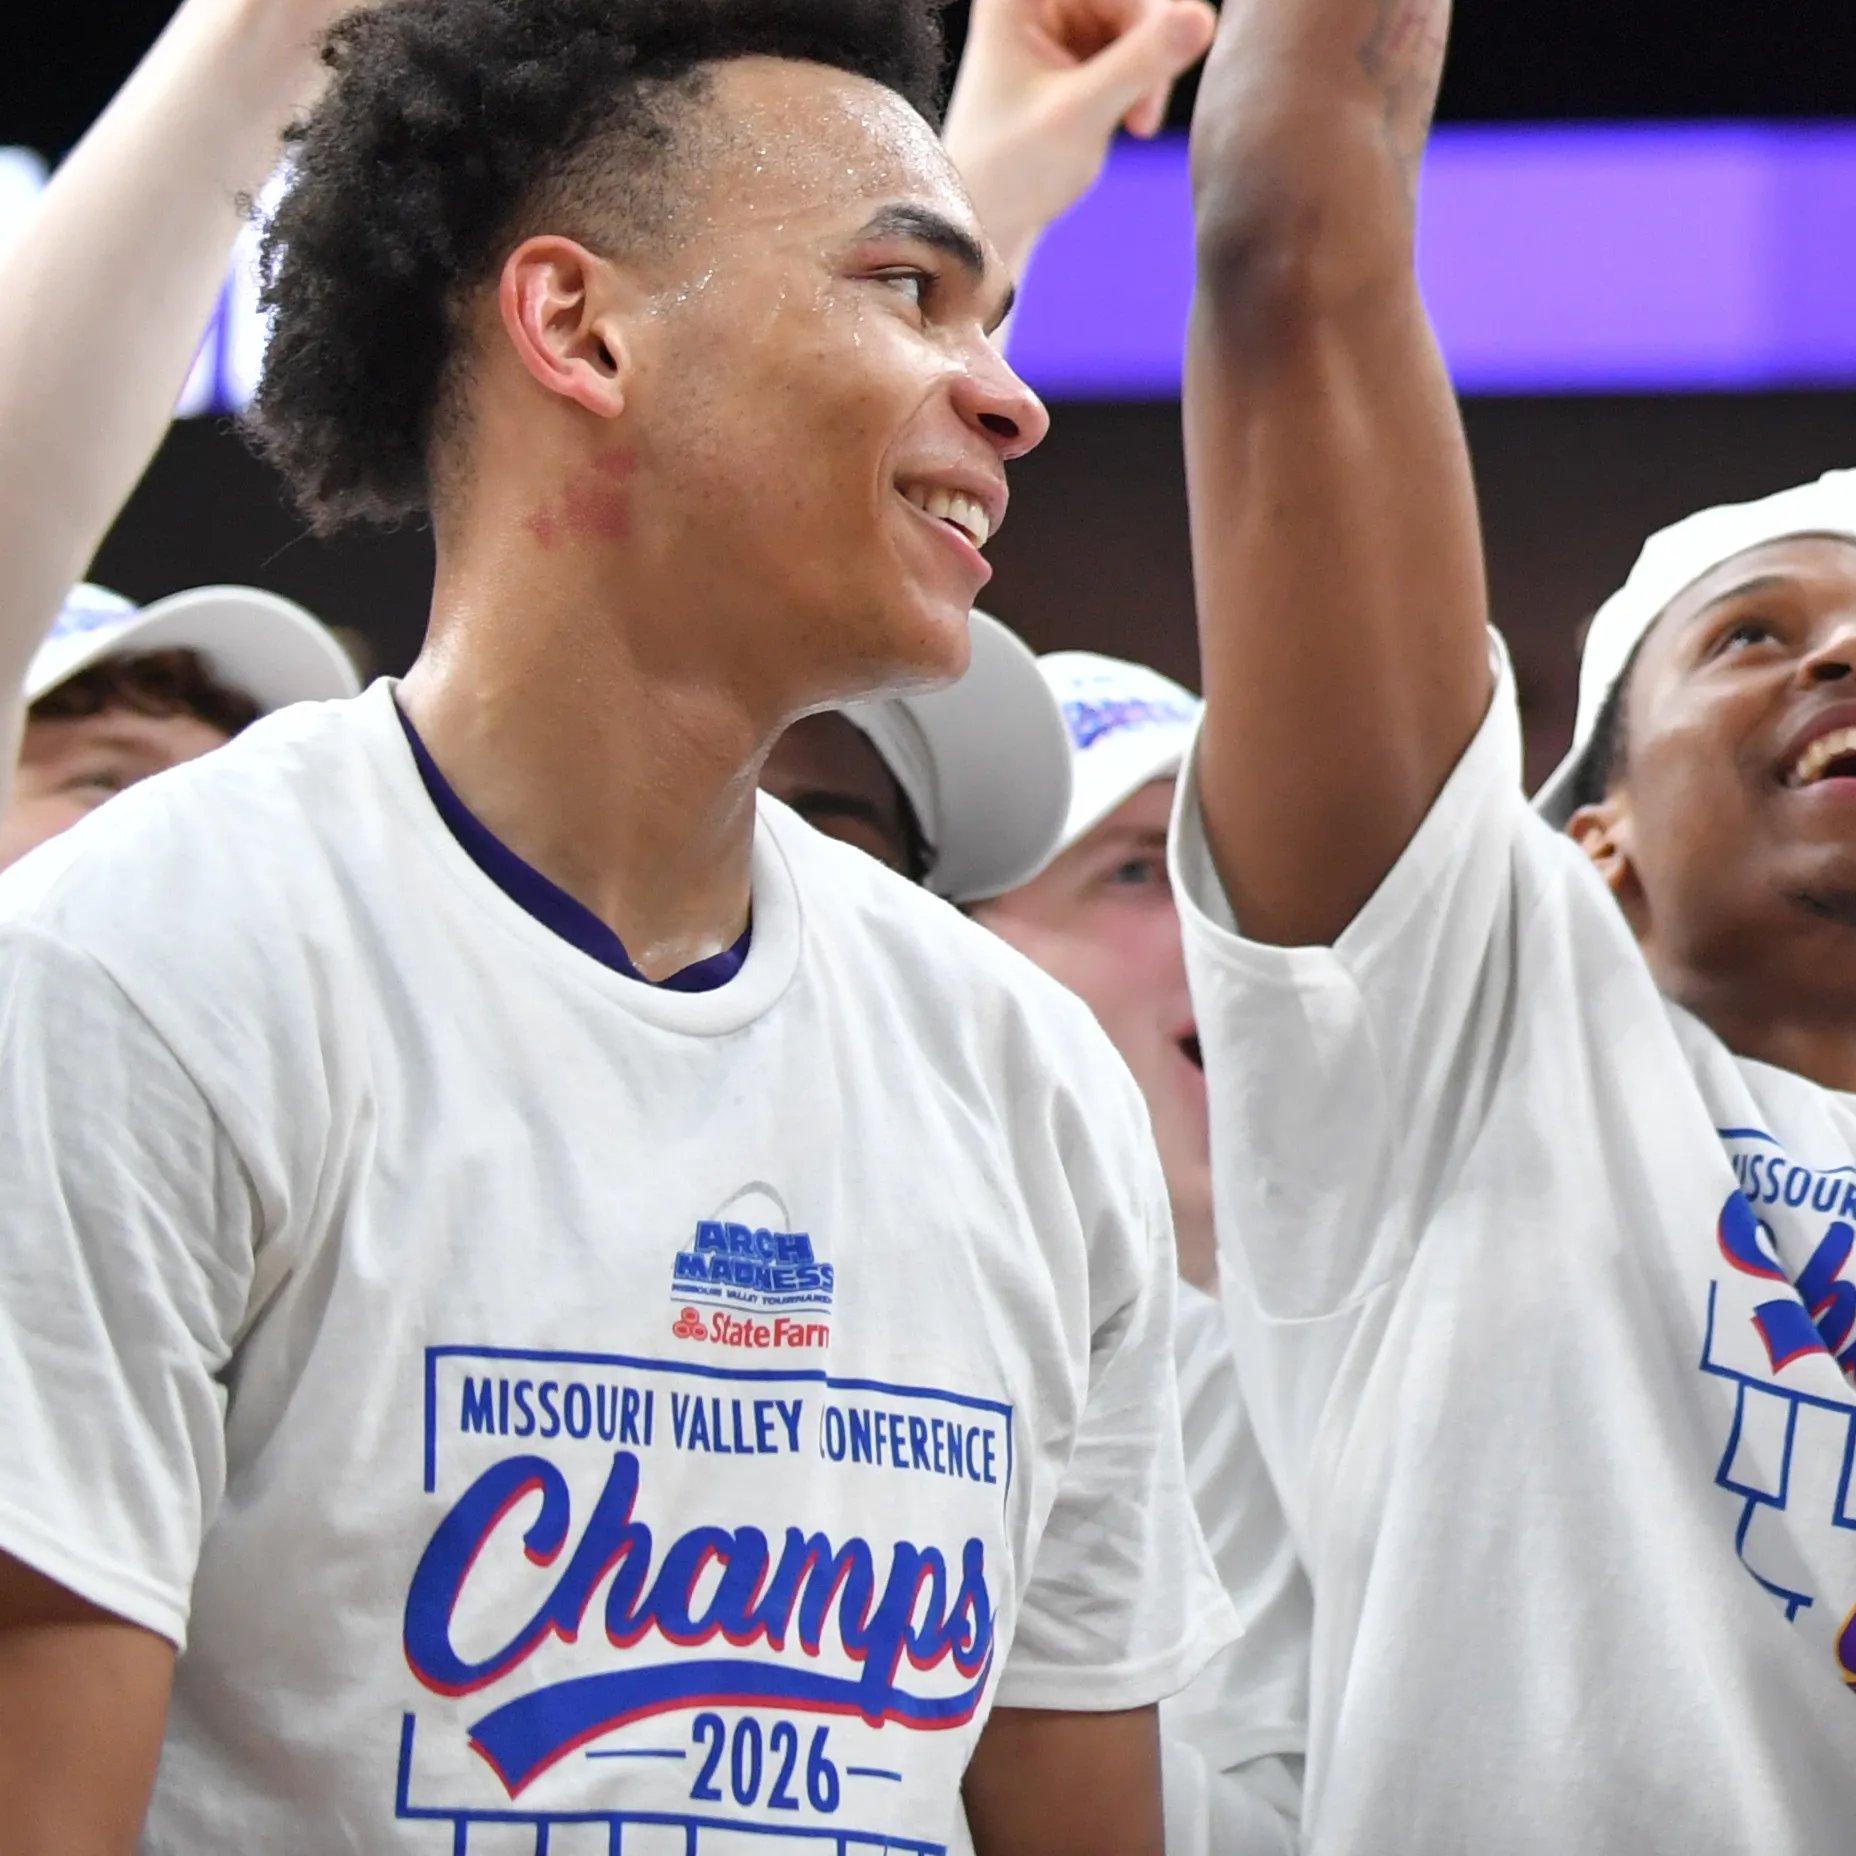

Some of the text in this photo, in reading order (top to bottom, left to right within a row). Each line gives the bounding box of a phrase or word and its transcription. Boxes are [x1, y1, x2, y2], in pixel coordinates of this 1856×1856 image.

[674, 1251, 834, 1293] MADNESS
[694, 1220, 815, 1265] ARCH
[460, 1376, 653, 1447] MISSOURI
[671, 1391, 804, 1456] VALLEY
[403, 1450, 997, 1729] Champs
[689, 1712, 841, 1813] 2026
